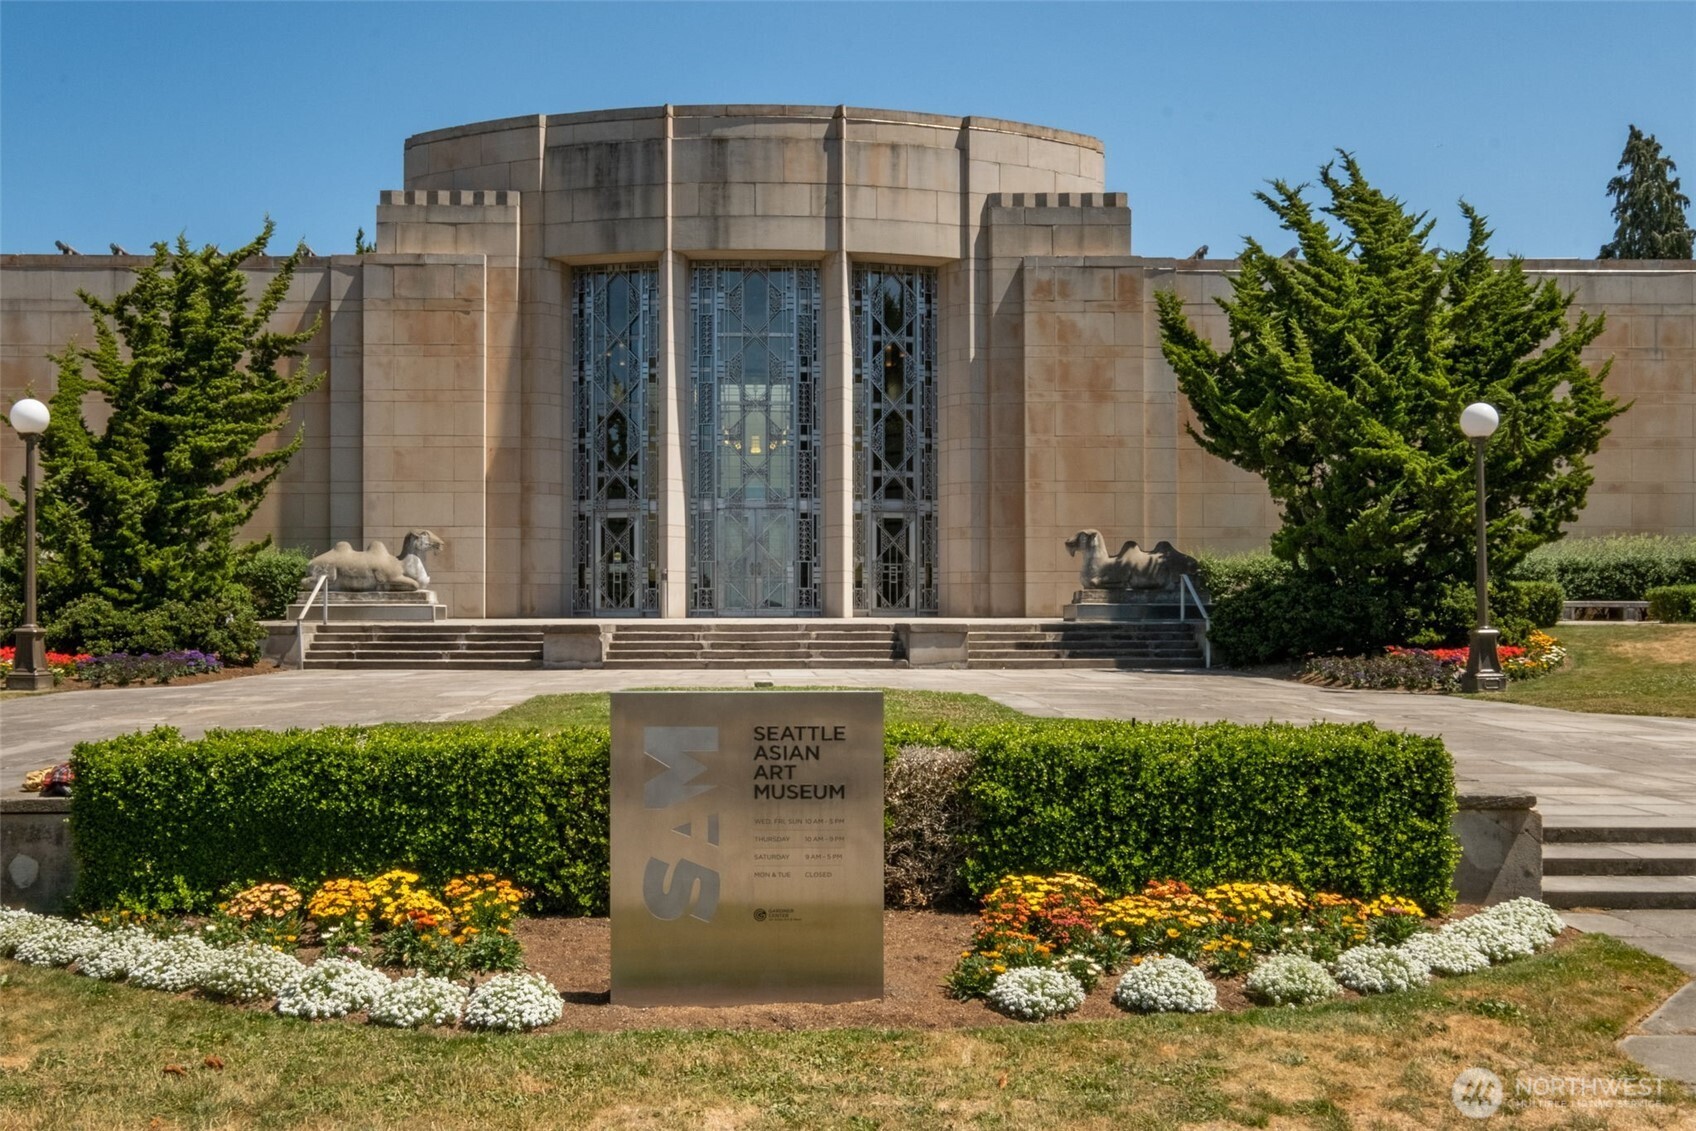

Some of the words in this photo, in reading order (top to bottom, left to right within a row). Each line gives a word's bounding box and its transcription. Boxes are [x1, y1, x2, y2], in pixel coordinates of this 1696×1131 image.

[753, 725, 846, 742] SEATTLE
[753, 745, 820, 761] ASIAN
[753, 765, 797, 780] ART
[753, 784, 845, 800] MUSEUM
[642, 726, 721, 923] SAM
